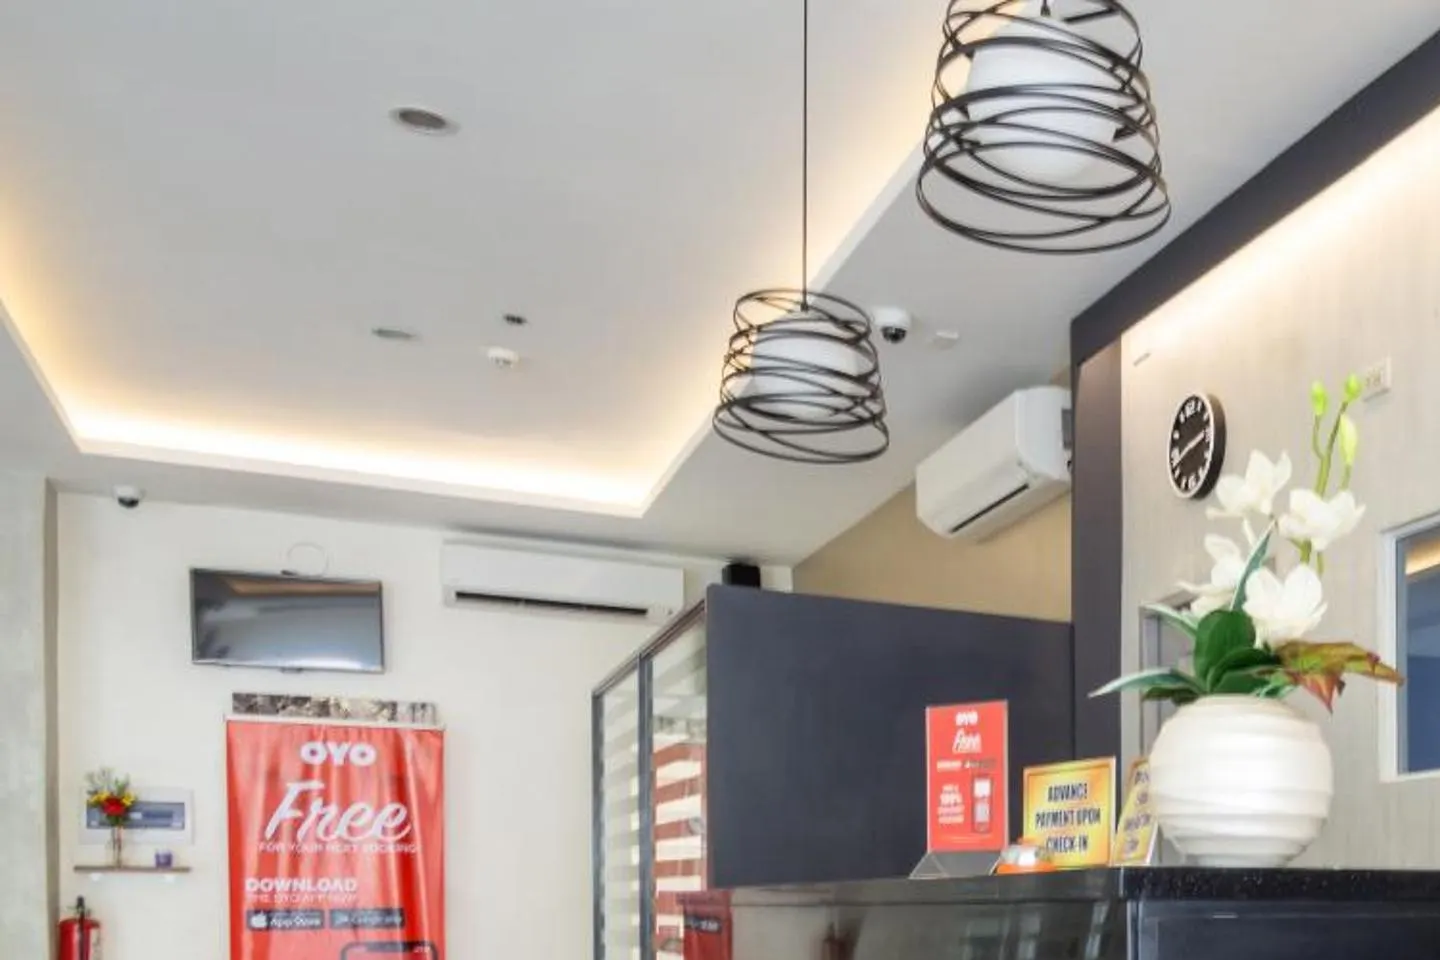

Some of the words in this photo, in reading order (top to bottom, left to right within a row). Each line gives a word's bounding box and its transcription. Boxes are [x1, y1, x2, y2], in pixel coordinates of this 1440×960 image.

[300, 740, 377, 767] OYO
[1048, 783, 1087, 802] ADVANCE
[264, 780, 412, 844] Free
[1035, 809, 1074, 830] PAYMENT
[1076, 807, 1101, 825] UPON
[245, 877, 358, 893] DOWNLOAD
[270, 917, 292, 929] App
